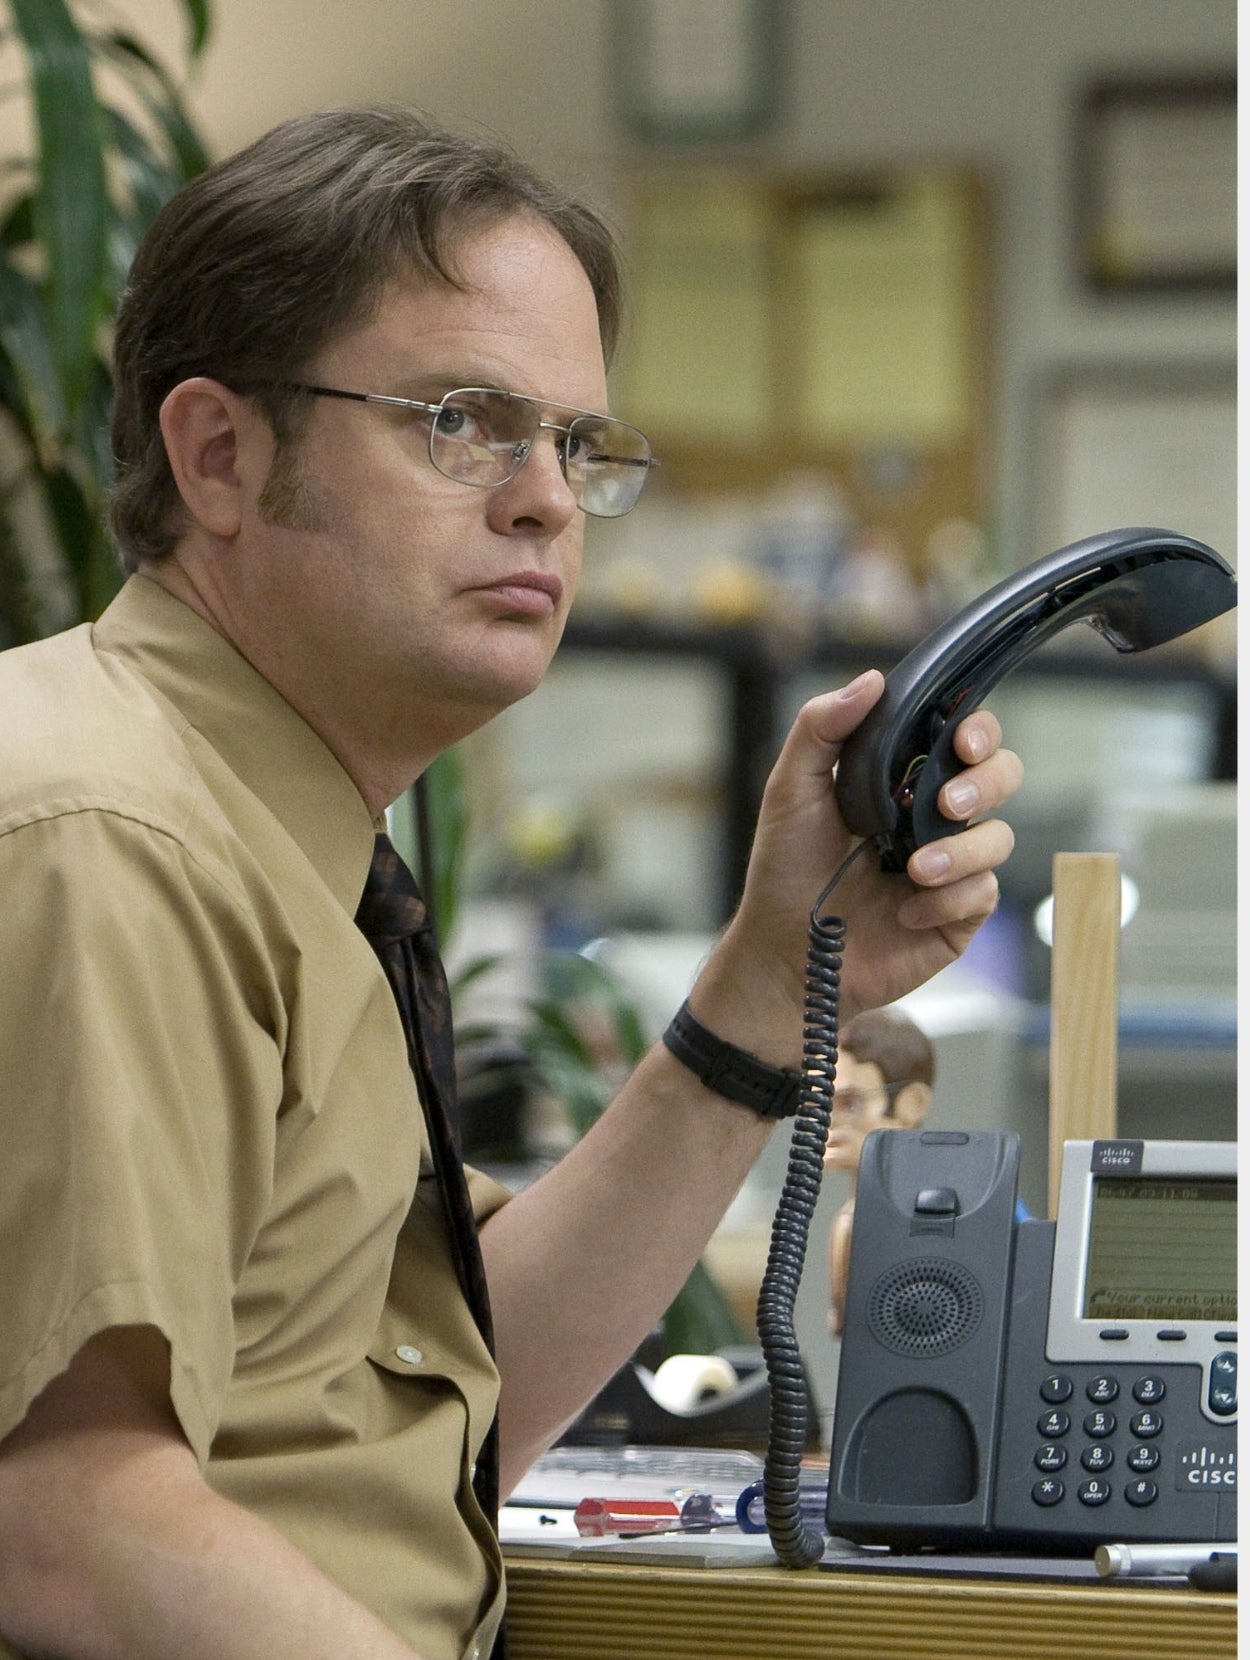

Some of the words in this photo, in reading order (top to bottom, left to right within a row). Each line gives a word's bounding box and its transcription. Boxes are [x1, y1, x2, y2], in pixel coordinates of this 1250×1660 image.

[1143, 1293, 1199, 1305] current
[1052, 1379, 1059, 1390] 1
[1098, 1379, 1107, 1391] 2
[1144, 1380, 1153, 1392] 3
[1049, 1413, 1058, 1424] 4
[1095, 1413, 1104, 1424] 5
[1142, 1413, 1151, 1425] 6
[1046, 1447, 1055, 1458] 7
[1093, 1447, 1102, 1459] 8
[1140, 1448, 1149, 1459] 9
[1089, 1481, 1099, 1492] 0
